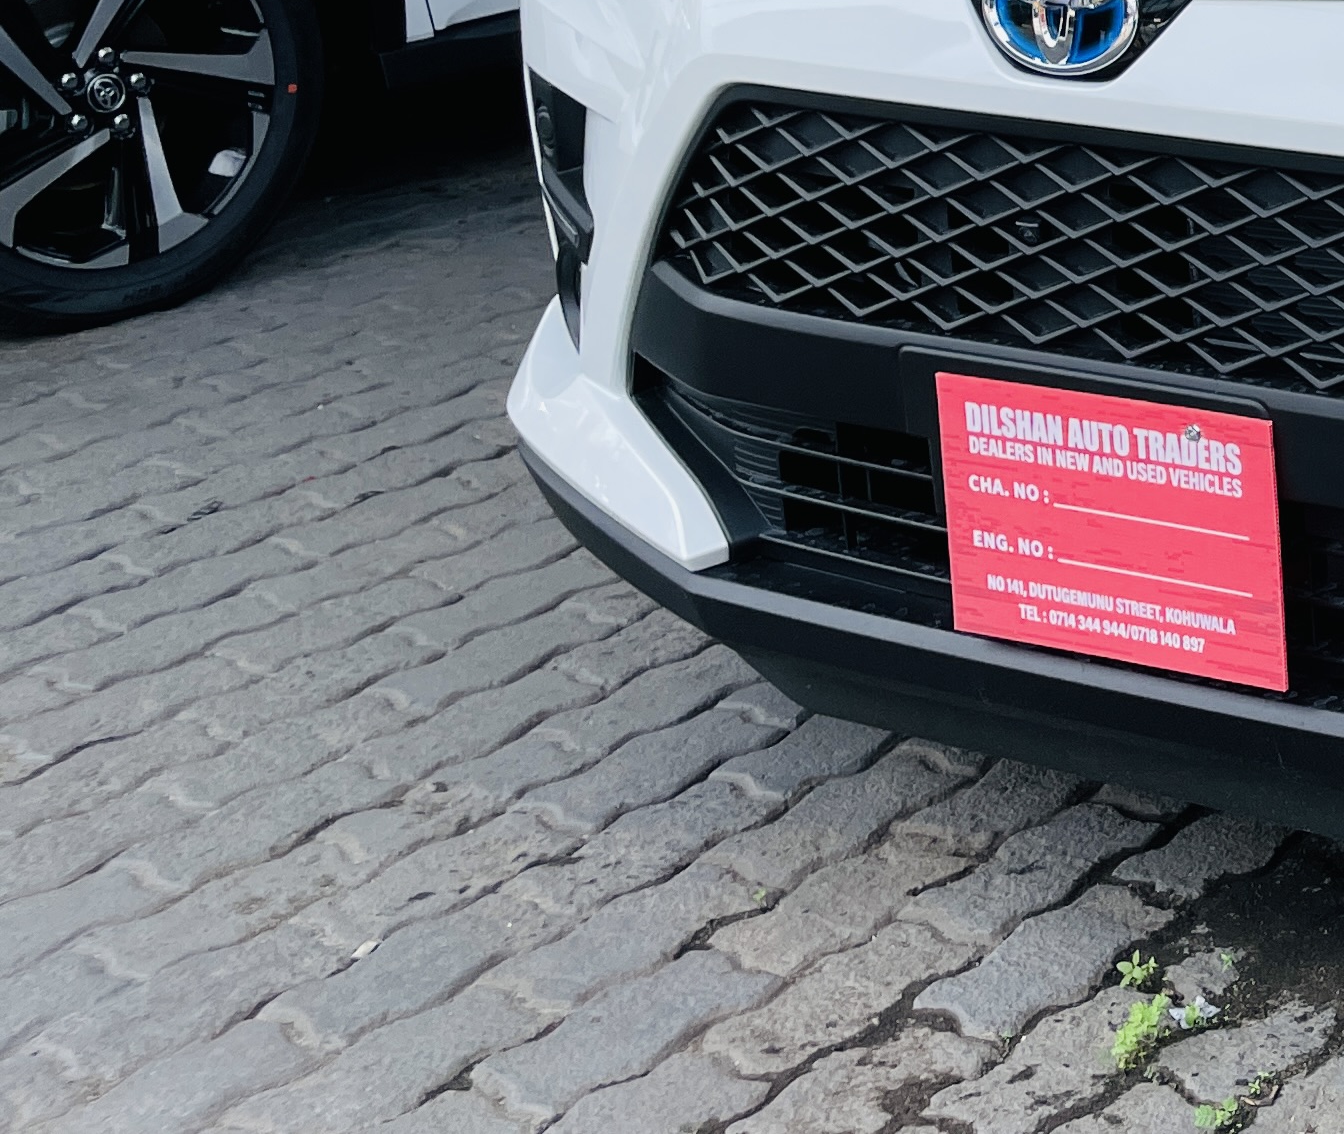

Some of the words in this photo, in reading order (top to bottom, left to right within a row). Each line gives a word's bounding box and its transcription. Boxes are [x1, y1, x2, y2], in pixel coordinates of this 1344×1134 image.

[964, 401, 1063, 447] DILSHAN
[1068, 417, 1130, 456] AUTO
[1133, 426, 1242, 476] TRADERS
[969, 435, 1034, 464] DEALERS
[1037, 446, 1052, 466] IN
[1055, 449, 1090, 472] NEW
[1092, 456, 1124, 478] AND
[1127, 461, 1166, 485] USED
[1169, 467, 1243, 498] VEHICLES
[968, 474, 1010, 497] CHA.
[973, 529, 1014, 553] ENG.
[987, 574, 1005, 592] NO
[1029, 581, 1114, 612] DUTUGEMUNU
[1115, 597, 1164, 623] STREET,
[1166, 607, 1237, 635] KOHUWALA
[1018, 603, 1041, 622] TEL
[1050, 609, 1077, 629] 0714
[1078, 615, 1101, 634] 344
[1160, 630, 1181, 650] 140
[1183, 635, 1206, 654] 897
